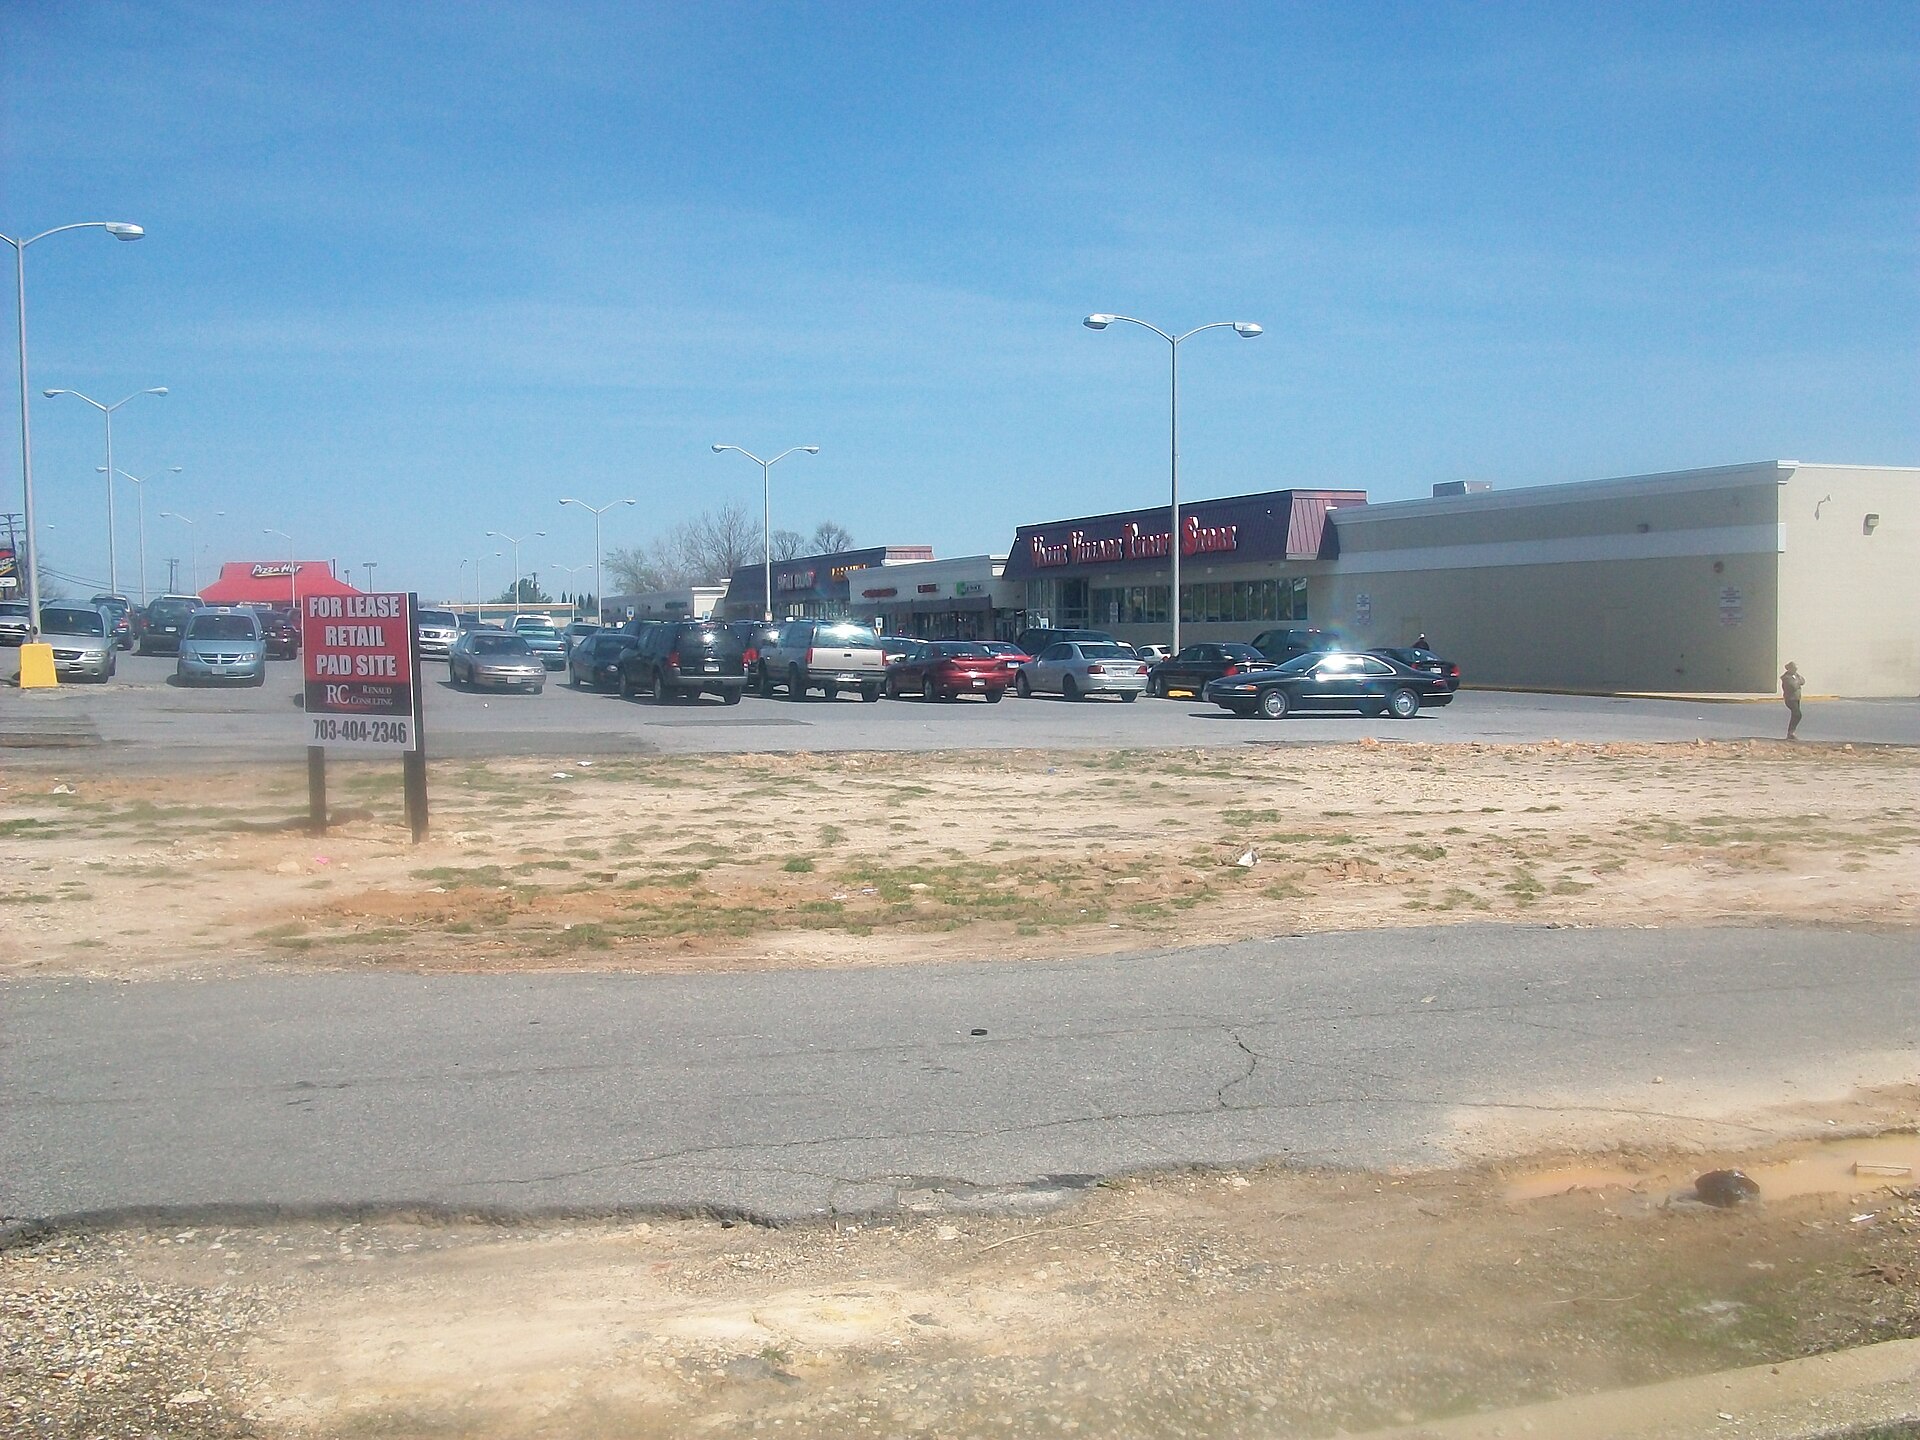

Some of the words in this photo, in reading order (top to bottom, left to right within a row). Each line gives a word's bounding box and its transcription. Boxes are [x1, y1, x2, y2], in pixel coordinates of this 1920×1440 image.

[1183, 516, 1238, 556] STORE
[309, 597, 342, 618] FOR
[347, 596, 400, 618] LEASE
[325, 626, 385, 647] RETAIL
[316, 654, 352, 675] PAD
[356, 654, 397, 677] SITE
[326, 684, 349, 704] RC
[350, 696, 393, 706] CONSULTING
[313, 719, 407, 743] 703-404-2346
